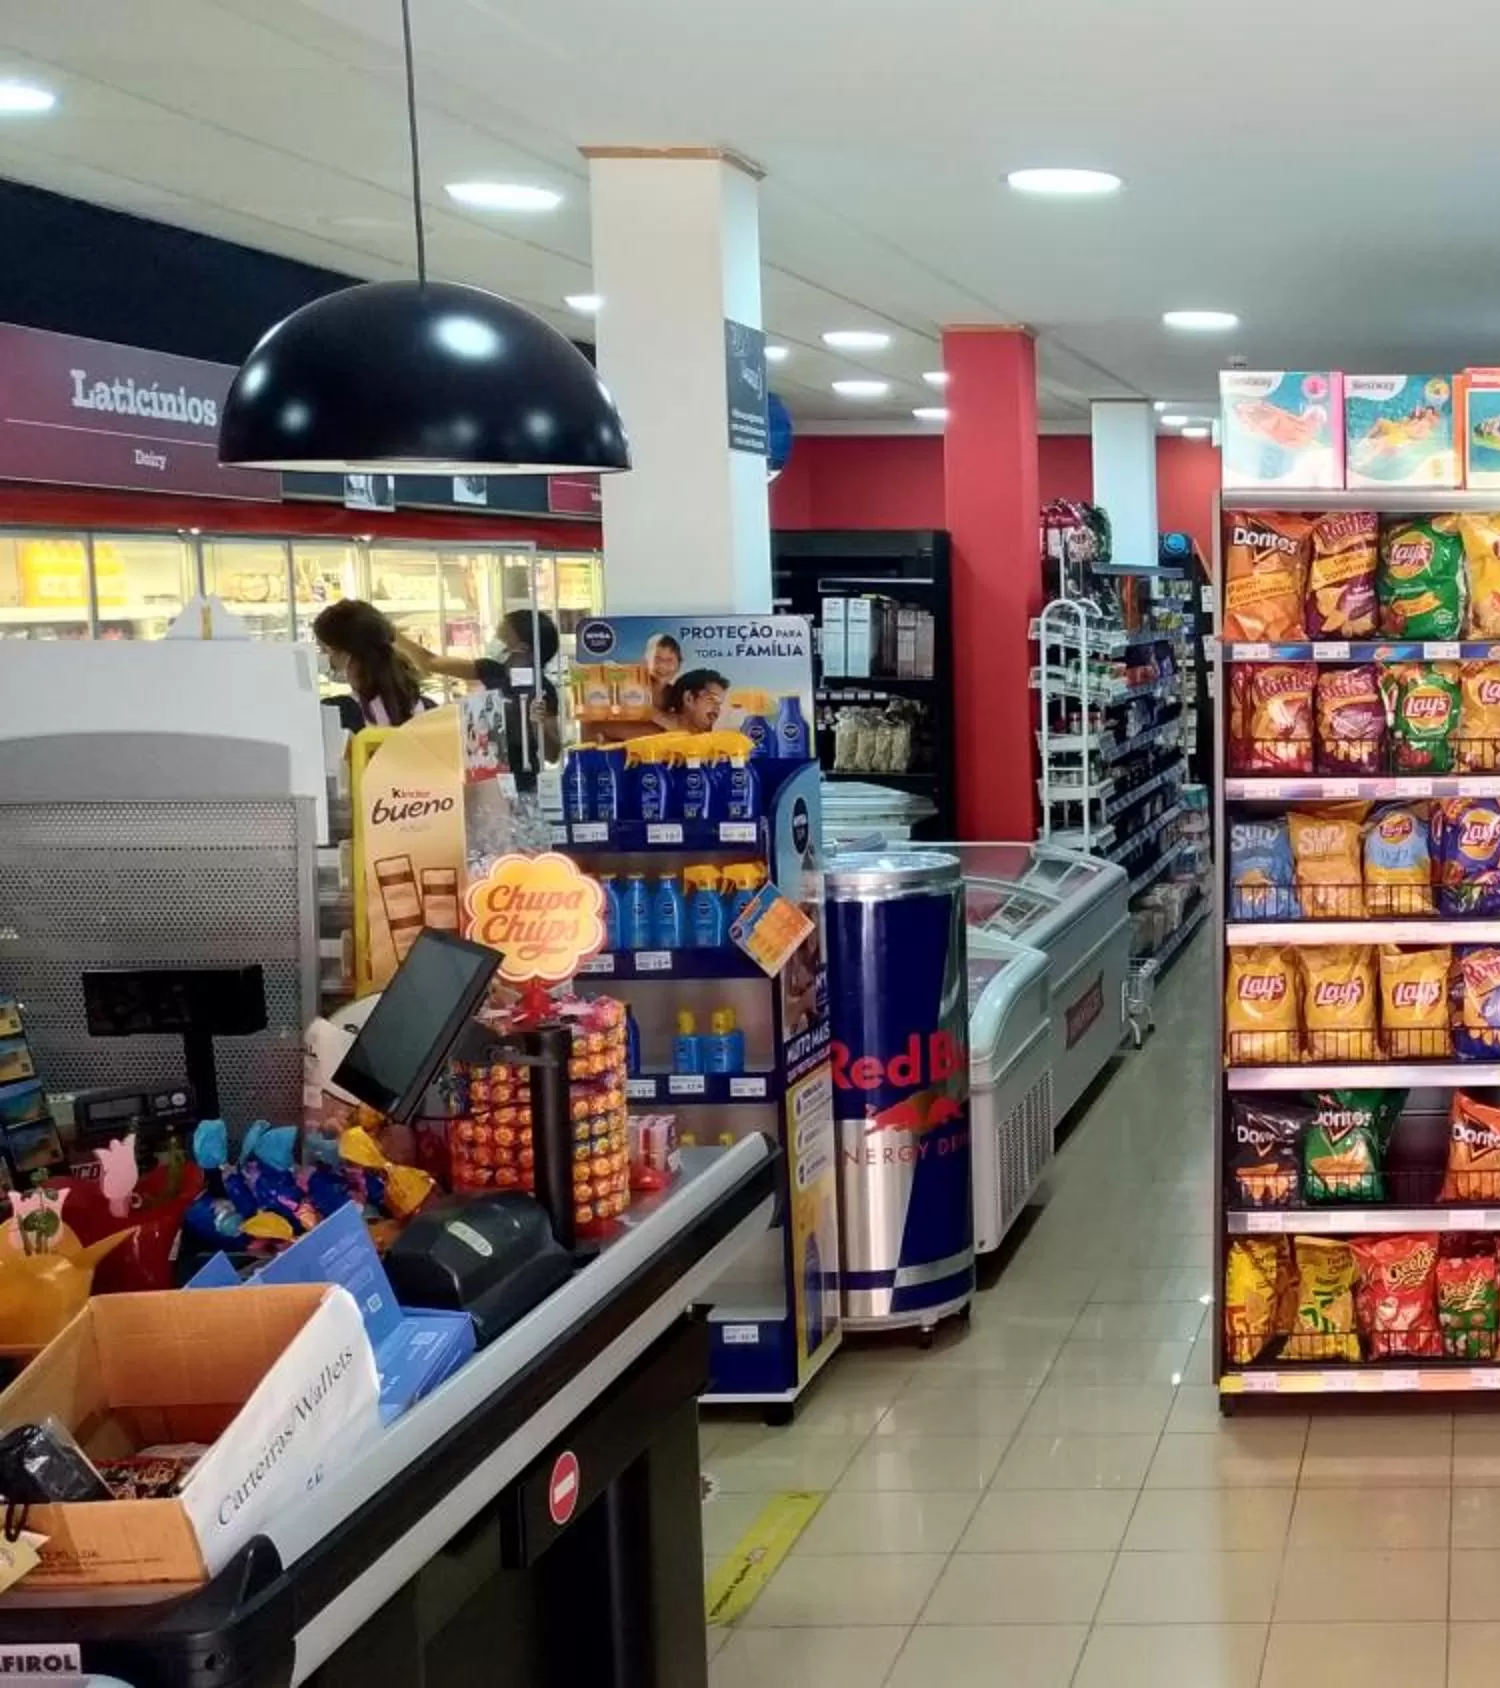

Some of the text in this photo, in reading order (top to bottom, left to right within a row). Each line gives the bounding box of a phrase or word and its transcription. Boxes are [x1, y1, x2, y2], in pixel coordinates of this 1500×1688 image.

[70, 368, 218, 427] Laticínios
[134, 449, 168, 471] Dairy
[1233, 527, 1299, 555] Doritos
[679, 621, 802, 644] PROTEÇÃO PARA
[735, 641, 803, 658] FAMÍLIA
[1405, 696, 1449, 718] Lay's
[371, 796, 454, 825] bueno
[487, 884, 583, 914] Chupa
[482, 914, 581, 953] Chups
[1239, 975, 1285, 1000] Lay's
[1315, 979, 1362, 1007] Lay's
[1394, 981, 1441, 1006] Lay's
[830, 1032, 921, 1089] Red
[842, 1142, 930, 1166] NERGY
[0, 1653, 77, 1674] FIROL
